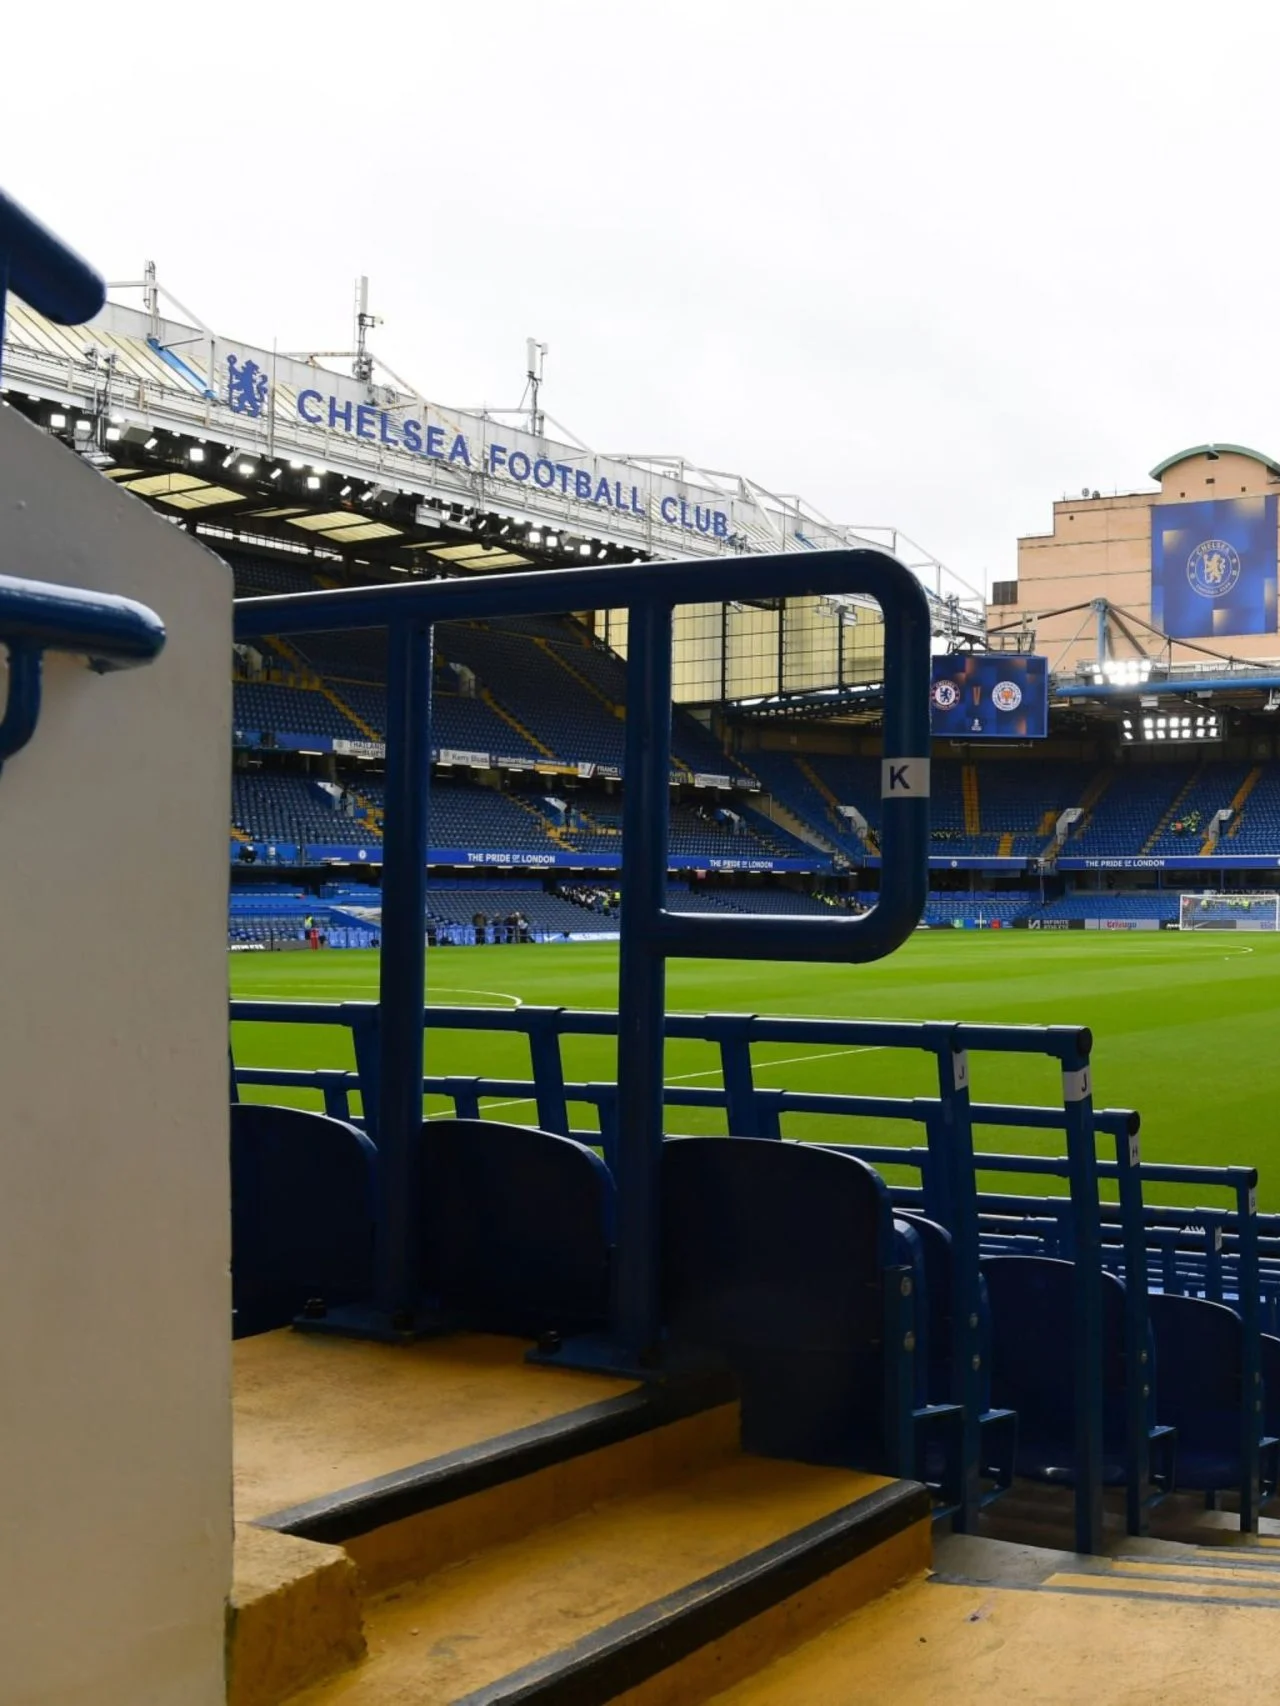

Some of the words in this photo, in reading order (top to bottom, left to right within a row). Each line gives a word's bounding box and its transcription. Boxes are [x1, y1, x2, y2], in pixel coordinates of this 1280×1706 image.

[297, 389, 472, 467] CHELSEA
[489, 443, 646, 516] FOOTBALL
[660, 496, 728, 537] CLUB
[889, 764, 911, 791] K
[467, 853, 484, 862] THE
[485, 853, 511, 863] PRIDE
[521, 854, 556, 864] LONDON
[709, 859, 722, 867] THE
[722, 860, 741, 868] PRIDE
[748, 860, 774, 869] LONDON
[1085, 859, 1099, 868] THE
[1100, 859, 1123, 867] PRIDE
[1133, 859, 1165, 867] LONDON
[1081, 1073, 1088, 1093] J
